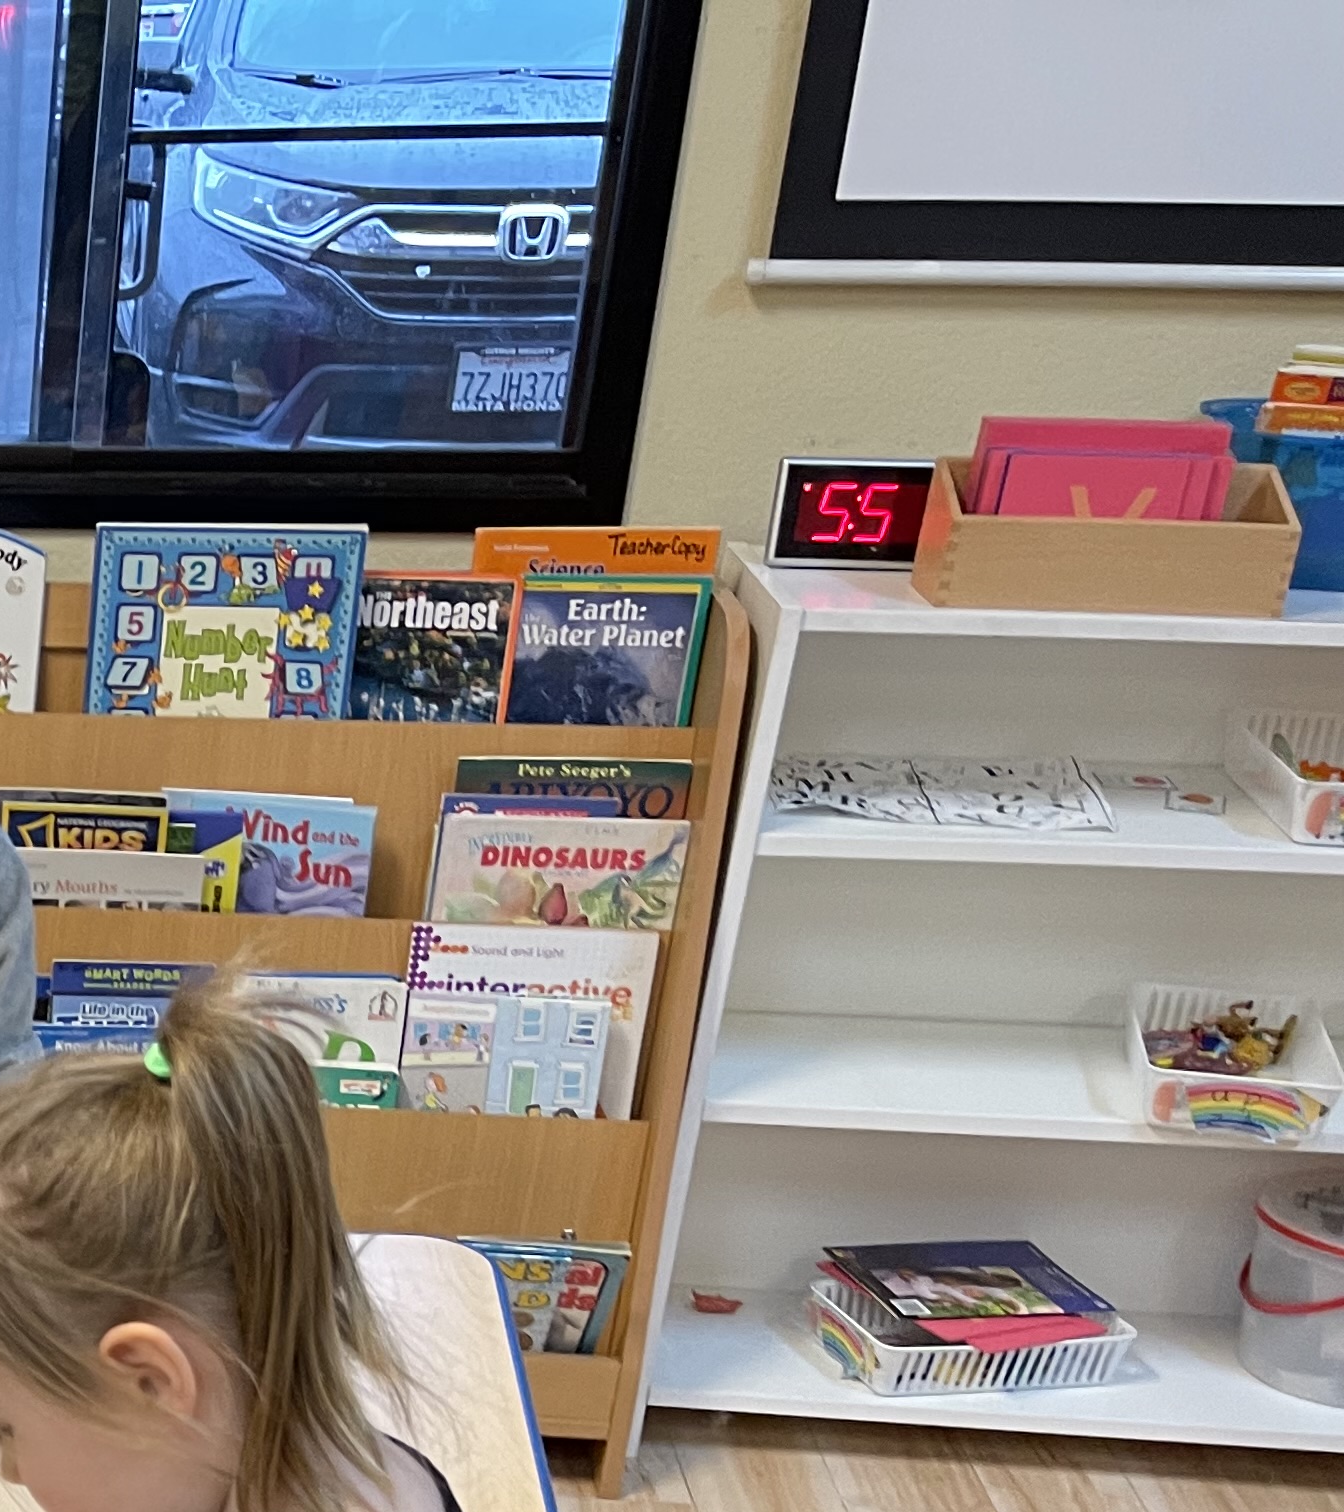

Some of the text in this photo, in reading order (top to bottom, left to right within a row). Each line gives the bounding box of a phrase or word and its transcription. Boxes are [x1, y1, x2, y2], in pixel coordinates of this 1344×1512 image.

[189, 561, 206, 585] 2
[251, 562, 268, 585] 3
[357, 594, 500, 632] Northeast
[567, 599, 647, 622] Earth:
[127, 611, 144, 636] 5
[163, 620, 273, 664] Number
[522, 624, 685, 649] Water Planet
[121, 661, 139, 683] 7
[180, 663, 248, 701] Hunt
[296, 667, 313, 690] 8
[518, 763, 632, 781] Pete Seeger's
[58, 827, 147, 852] KIDS
[312, 831, 335, 845] and
[294, 848, 353, 888] Sun
[480, 845, 647, 872] DINOSAURS
[471, 944, 509, 957] Sound
[511, 945, 536, 958] and
[537, 945, 565, 961] Light
[84, 967, 181, 983] SMART WORDS
[82, 1002, 155, 1018] Life in the
